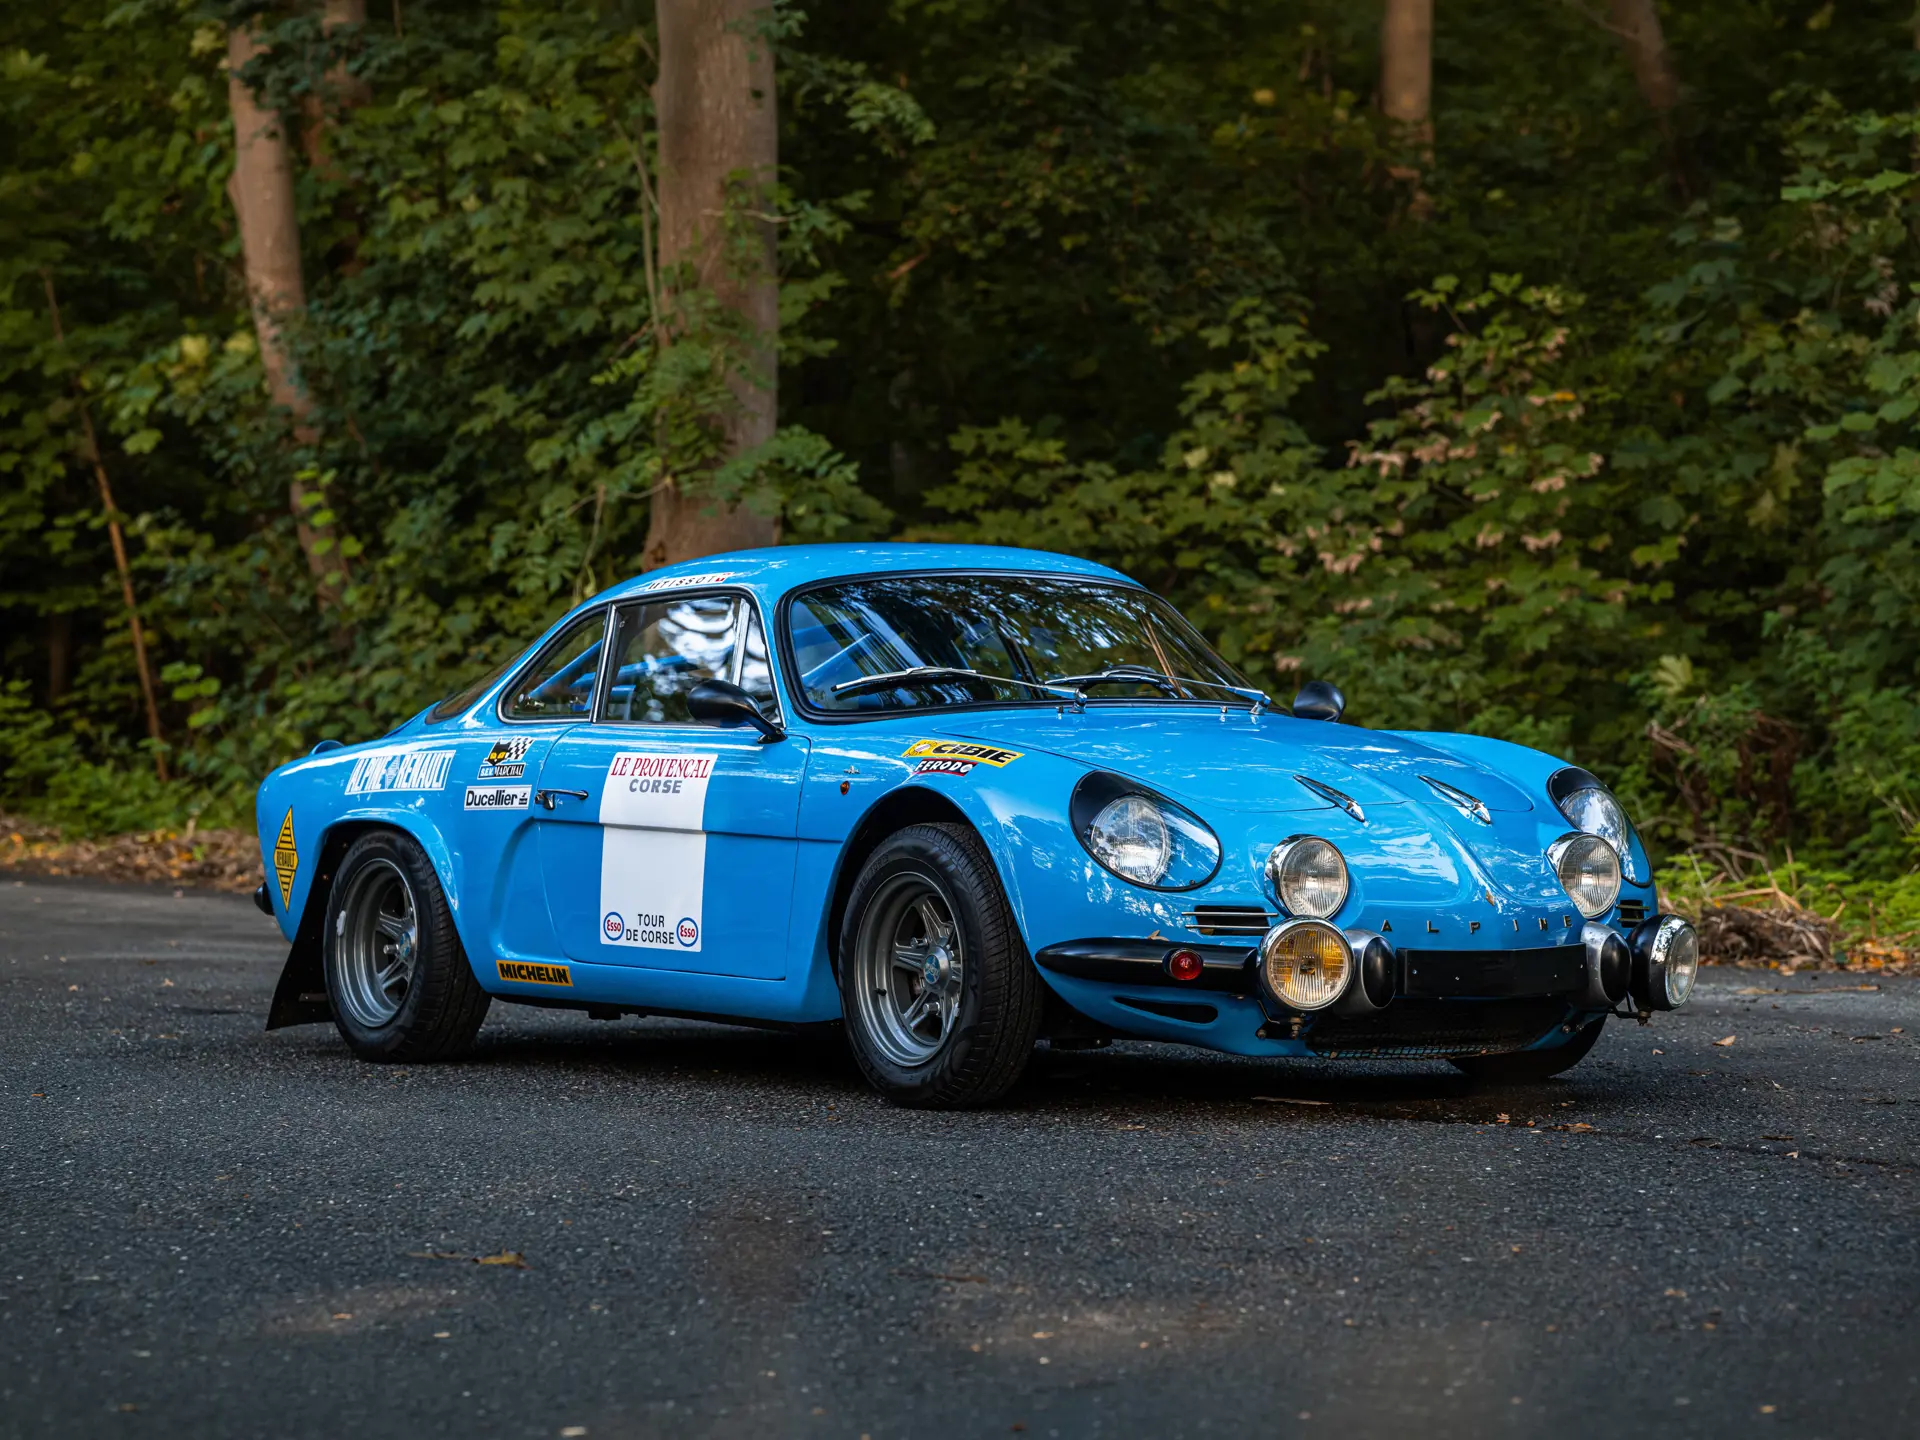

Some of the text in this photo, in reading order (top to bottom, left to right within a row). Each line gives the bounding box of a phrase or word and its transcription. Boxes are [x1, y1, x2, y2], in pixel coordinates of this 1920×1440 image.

[658, 575, 716, 589] TISSOT
[348, 751, 453, 793] ALPINE RENAULT
[494, 764, 523, 777] MARCHAL
[611, 757, 710, 779] LE PROVENÇAL
[914, 760, 974, 773] FERODO
[629, 779, 683, 794] CORSE
[465, 789, 518, 807] Ducellier
[637, 913, 665, 928] TOUR
[1380, 915, 1572, 935] ALPINE
[625, 928, 675, 945] DE CORSE
[499, 963, 569, 984] MICHELIN
